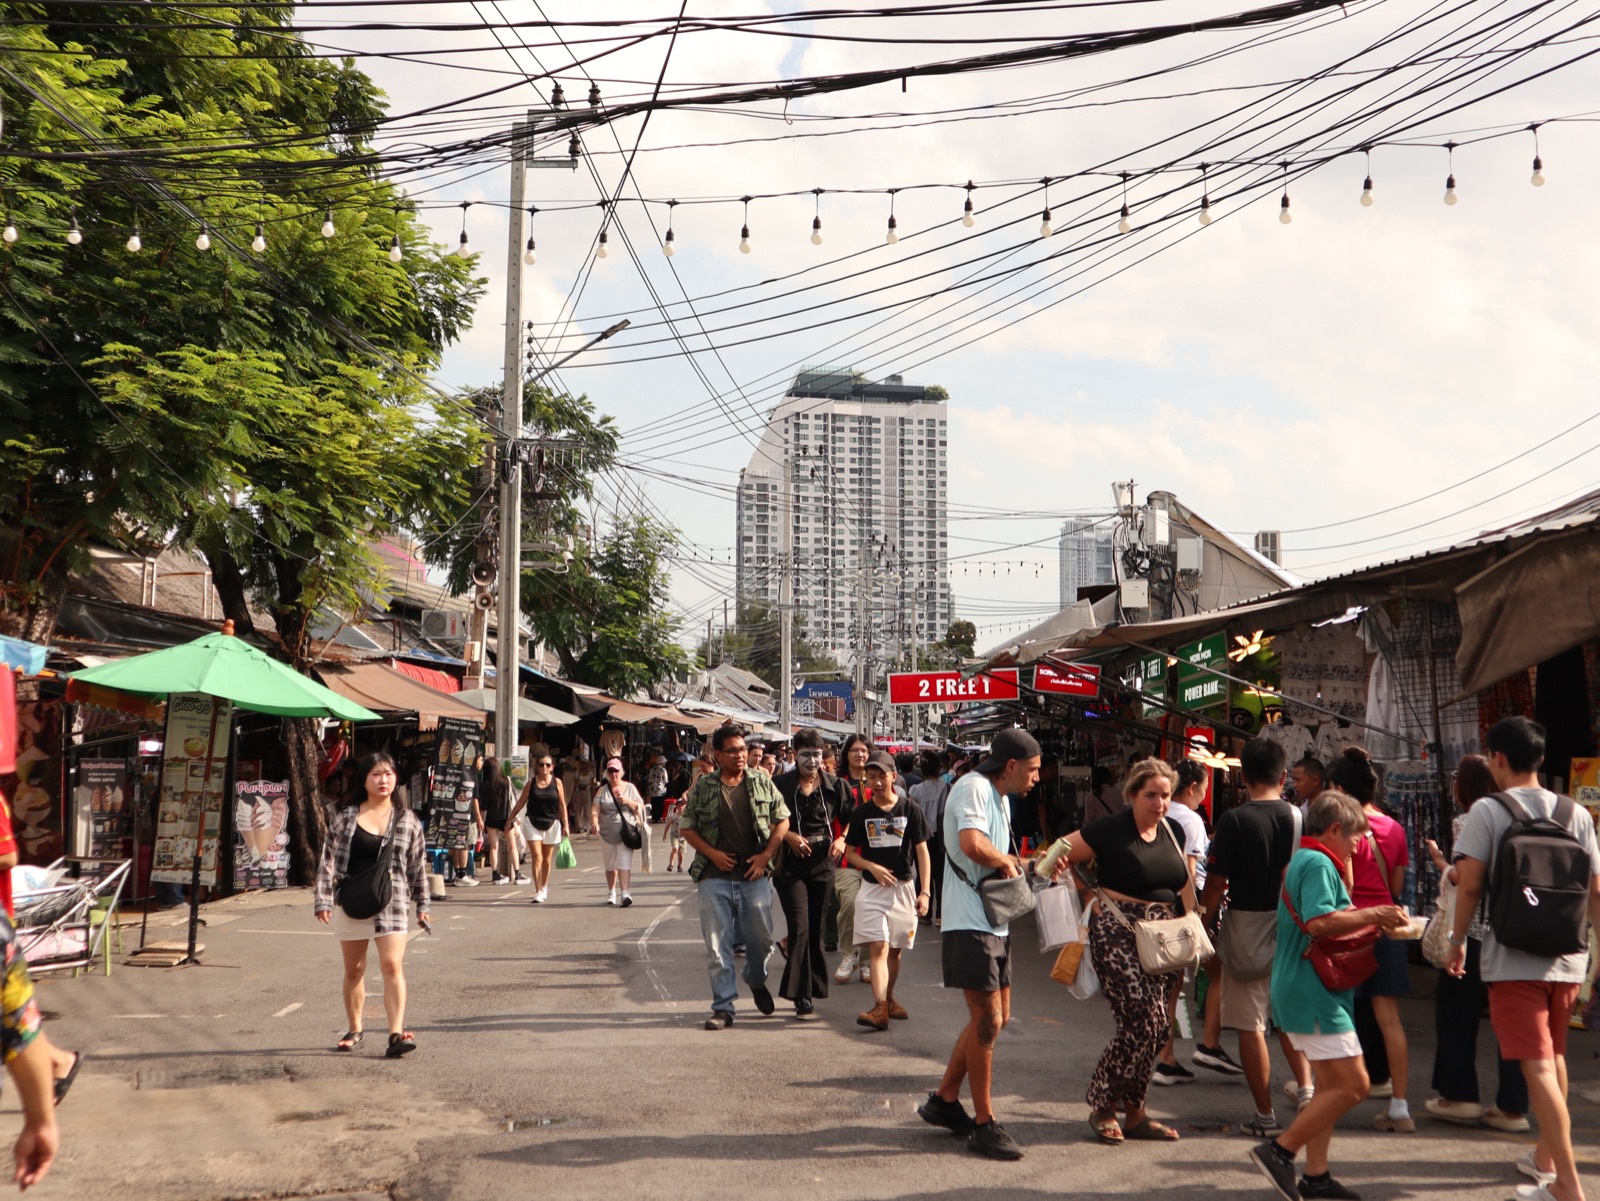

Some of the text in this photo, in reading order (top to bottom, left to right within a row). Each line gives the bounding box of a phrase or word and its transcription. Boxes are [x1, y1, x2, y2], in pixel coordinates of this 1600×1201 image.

[918, 678, 990, 697] 2 FREE 1
[1185, 682, 1202, 702] POWER
[1203, 680, 1219, 696] BANK
[444, 723, 460, 731] Menu
[238, 781, 288, 797] Puripuri
